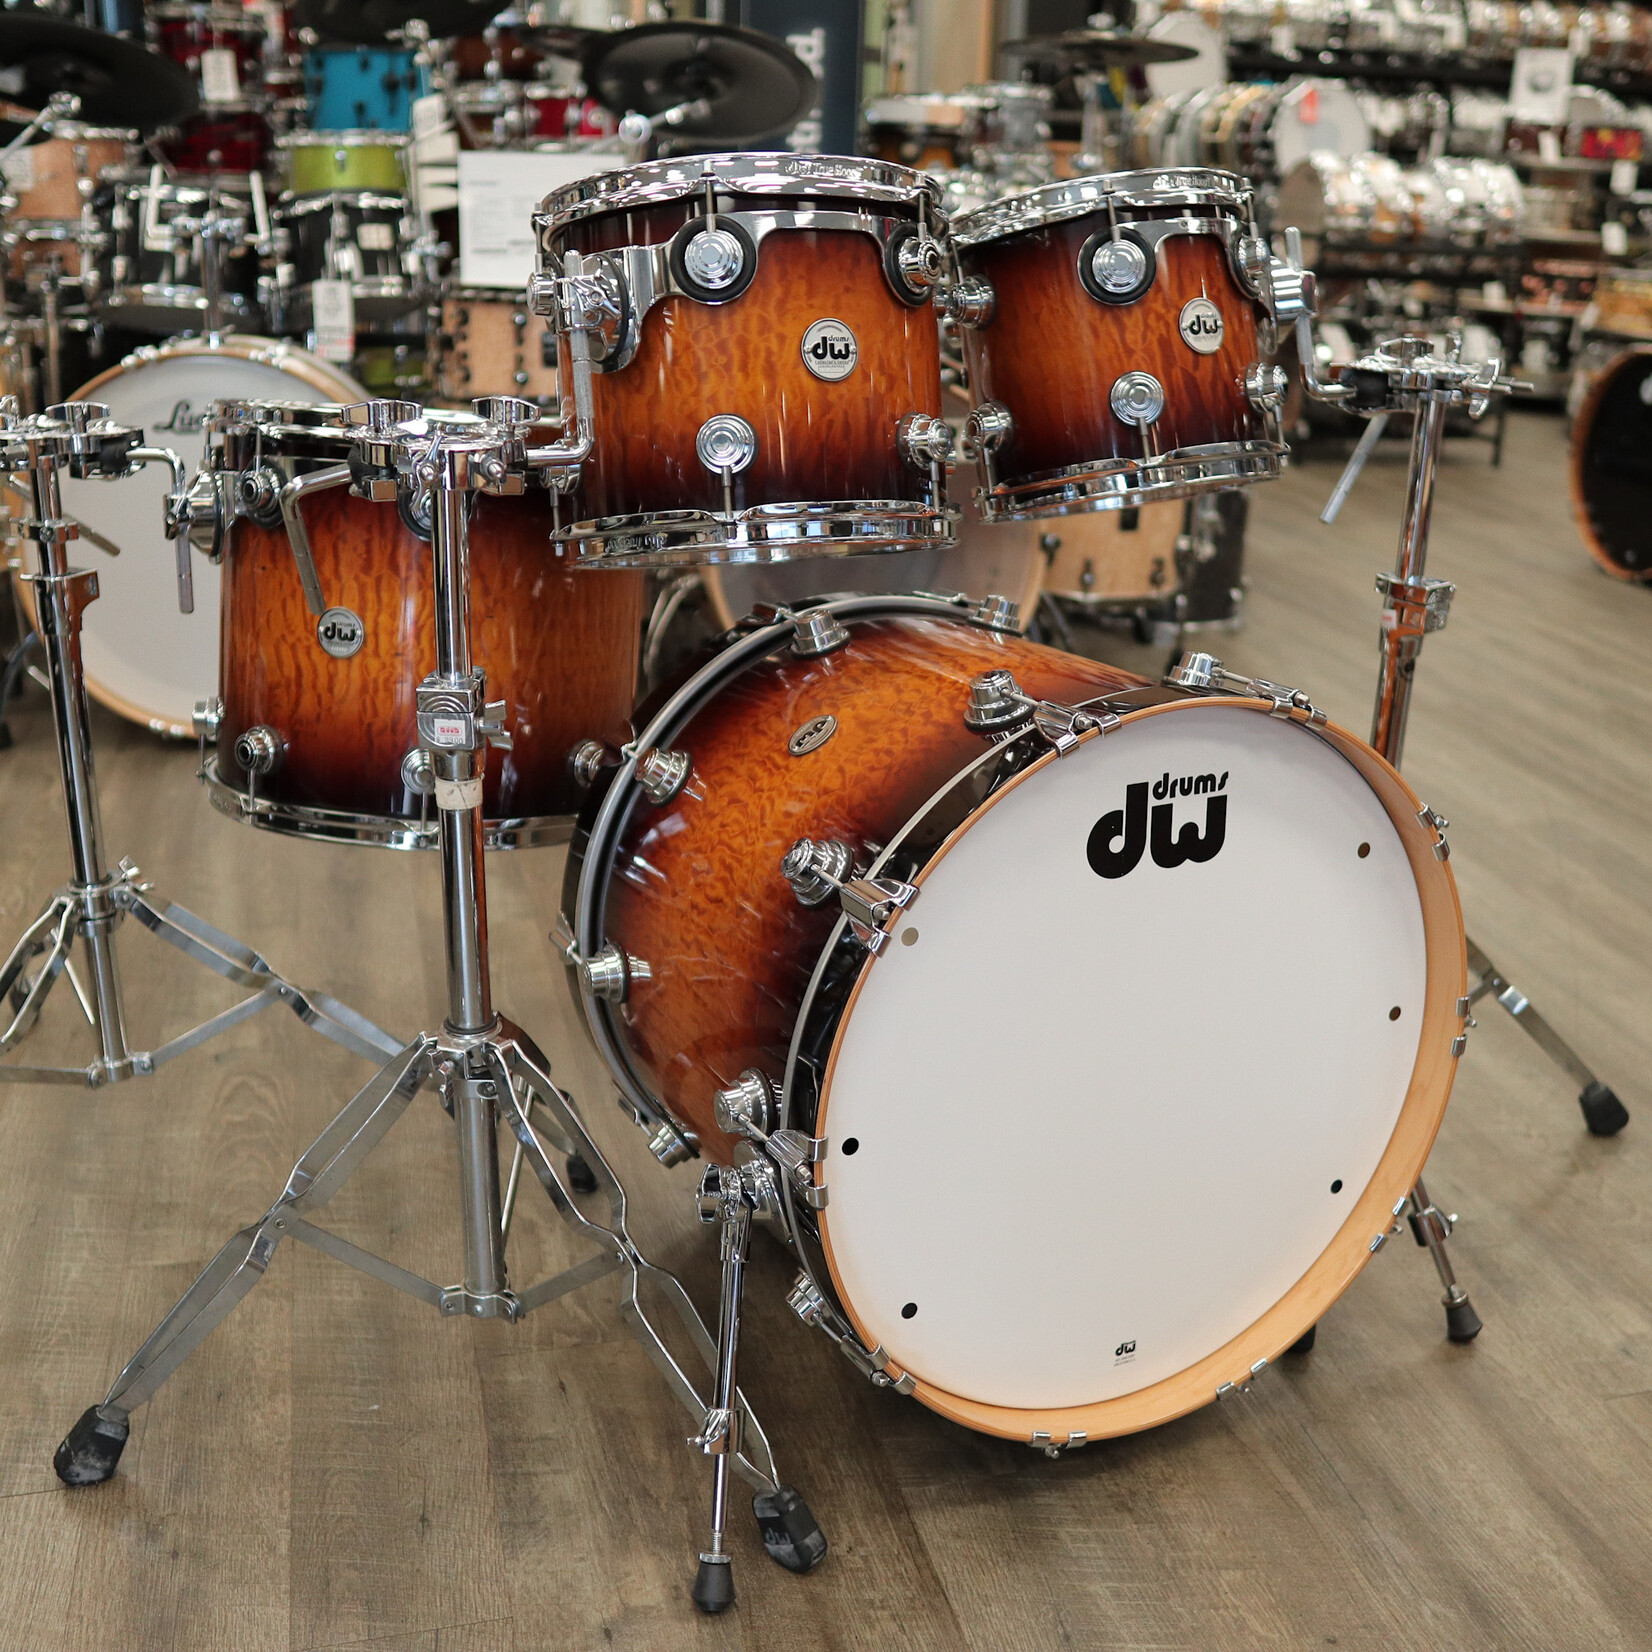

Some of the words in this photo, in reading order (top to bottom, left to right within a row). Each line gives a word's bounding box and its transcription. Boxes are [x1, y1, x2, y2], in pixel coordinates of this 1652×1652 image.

[1188, 314, 1219, 336] dw
[811, 335, 851, 361] dw
[323, 621, 356, 642] dw
[1152, 770, 1229, 801] drums
[1086, 782, 1229, 880] dw
[1114, 1341, 1137, 1357] dw
